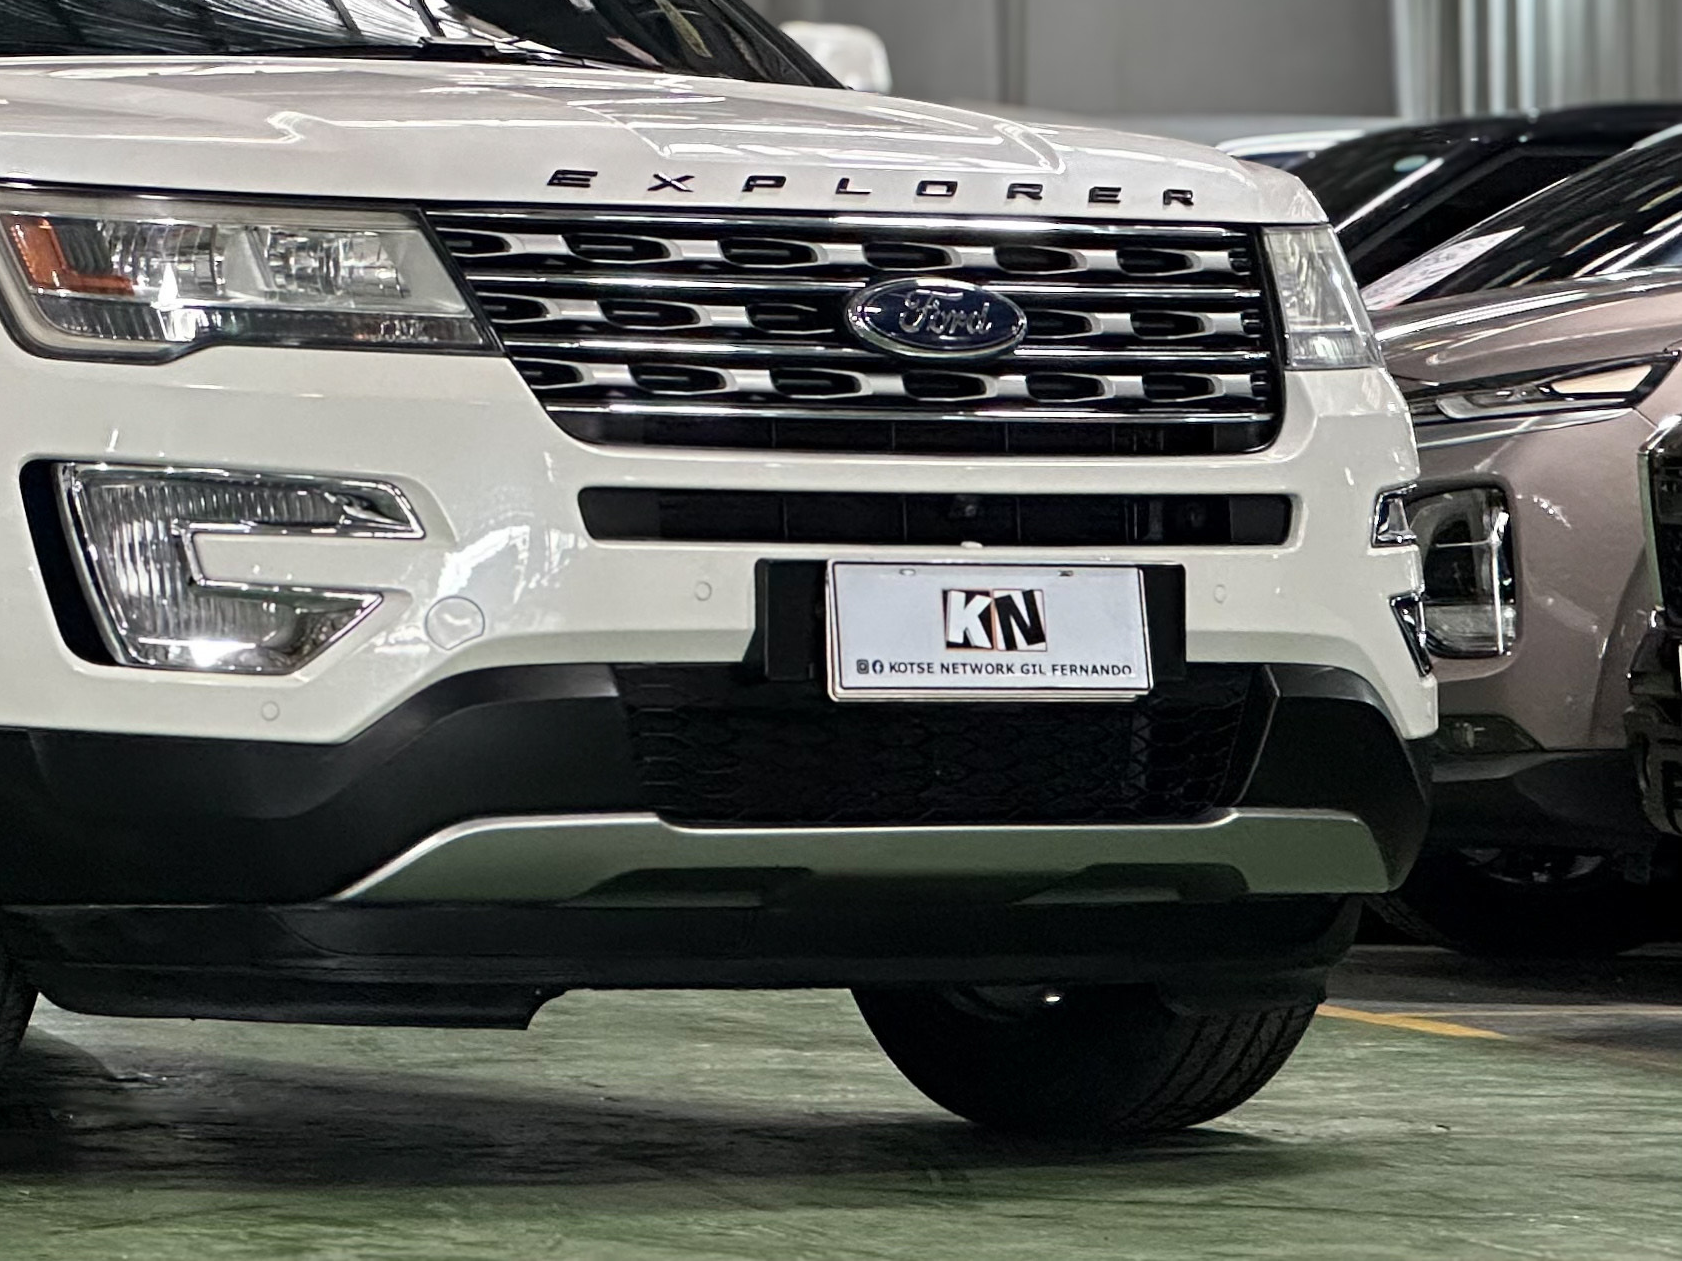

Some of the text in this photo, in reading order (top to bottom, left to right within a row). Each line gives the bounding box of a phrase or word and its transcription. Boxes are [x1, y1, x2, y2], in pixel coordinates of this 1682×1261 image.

[547, 169, 1196, 206] EXPLORER
[900, 291, 992, 335] Ford
[946, 590, 1047, 651] KN
[889, 661, 1133, 677] KOTSE NETWORK GIL FERNANDO
